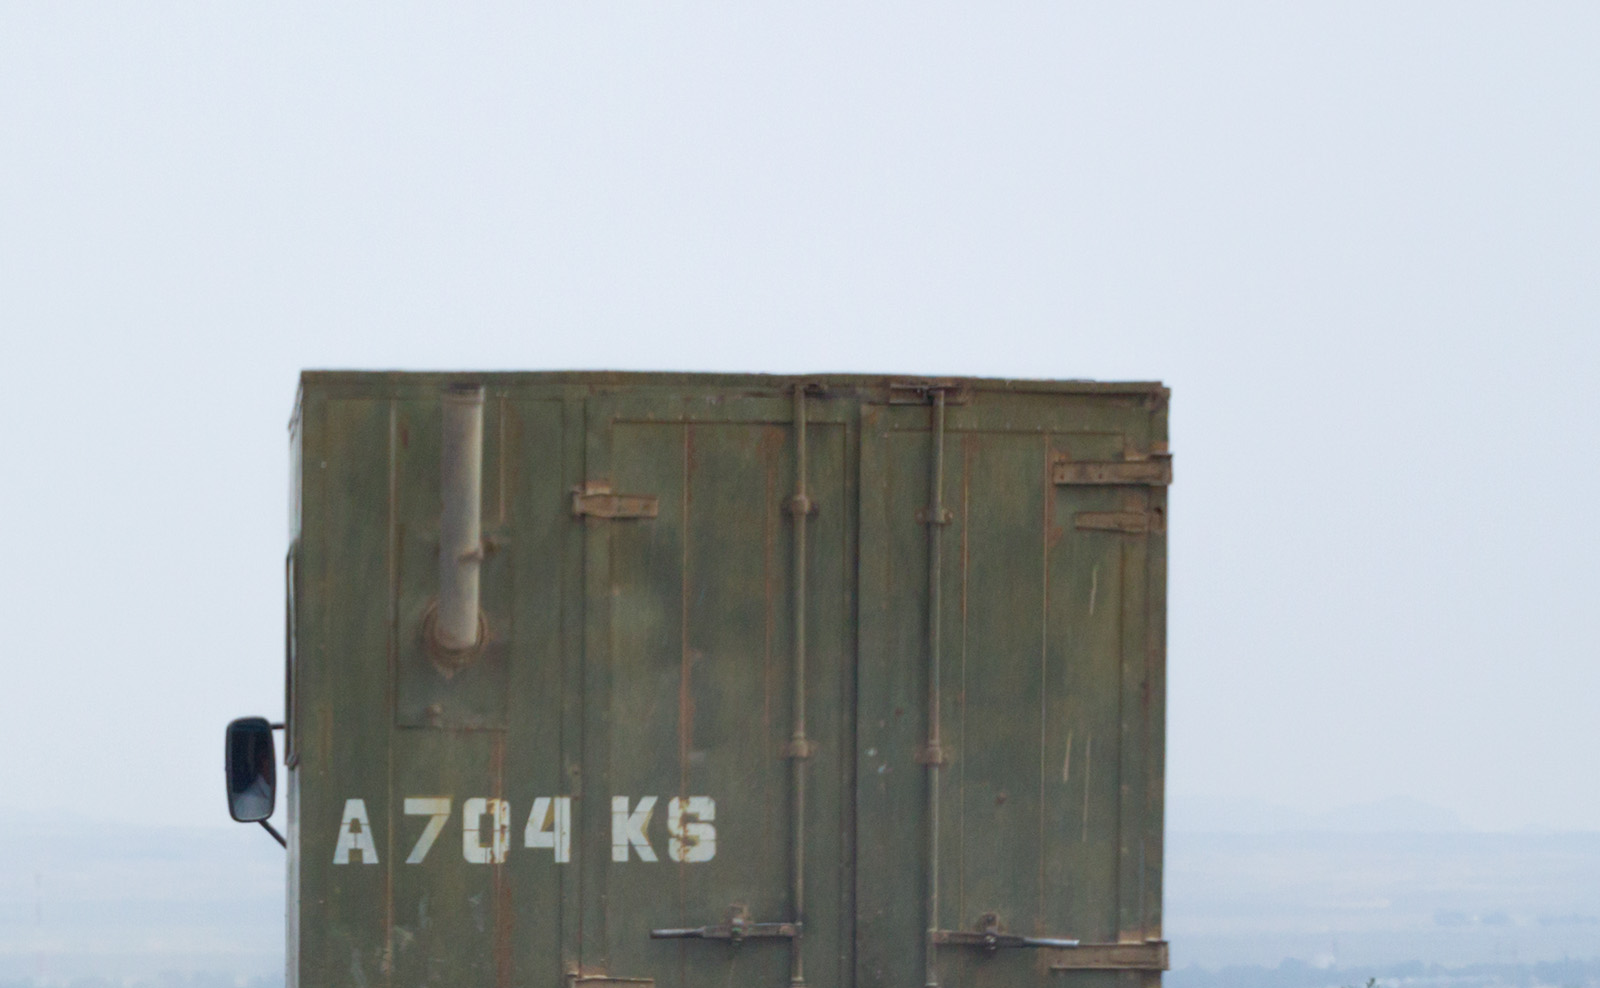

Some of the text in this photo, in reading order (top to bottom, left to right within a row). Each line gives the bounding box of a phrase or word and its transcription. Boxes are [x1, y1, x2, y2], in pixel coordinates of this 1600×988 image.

[333, 795, 717, 865] A 704 KS
